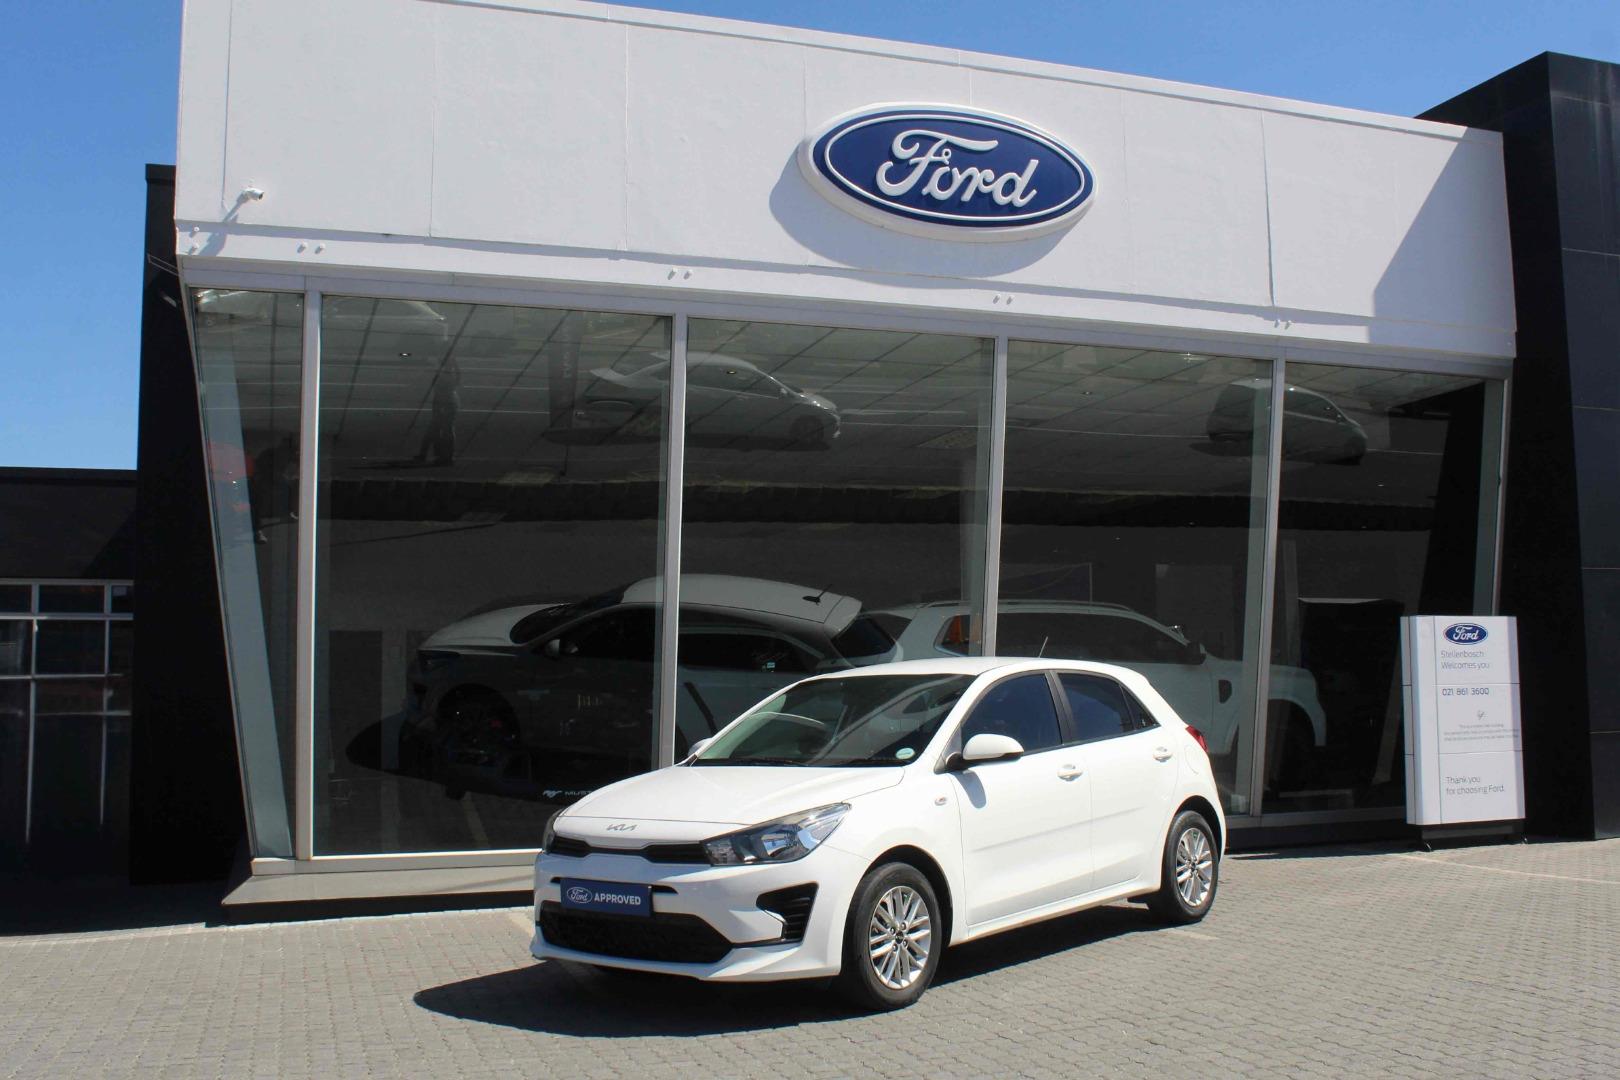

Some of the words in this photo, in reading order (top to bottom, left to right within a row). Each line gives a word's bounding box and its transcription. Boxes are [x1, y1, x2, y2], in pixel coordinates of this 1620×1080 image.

[875, 129, 1039, 208] Ford
[1452, 626, 1479, 641] Ford
[1440, 650, 1485, 659] Stellenbosch
[1477, 662, 1489, 670] you
[1442, 688, 1454, 696] 021
[1456, 688, 1468, 696] 861
[1471, 687, 1490, 696] 3600
[1446, 776, 1467, 785] Thank
[1468, 776, 1480, 785] you
[1446, 787, 1456, 796] for
[1457, 785, 1488, 796] choosing
[606, 823, 638, 832] KIA
[570, 887, 589, 901] Ford
[593, 893, 641, 905] APPROVED
